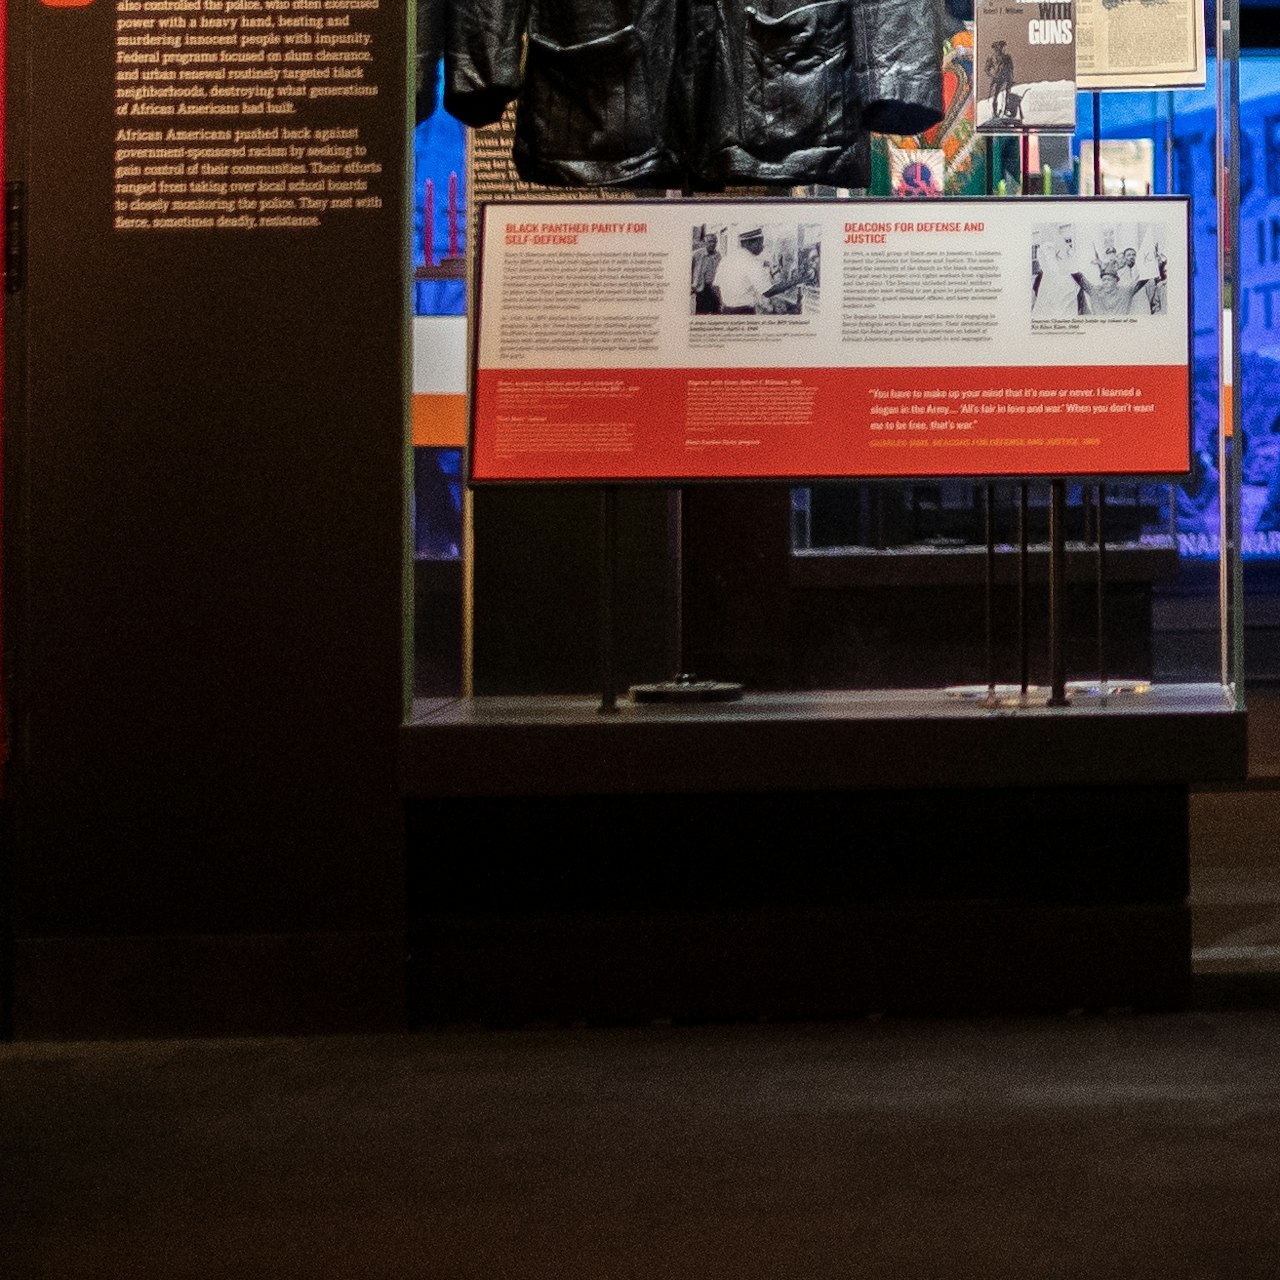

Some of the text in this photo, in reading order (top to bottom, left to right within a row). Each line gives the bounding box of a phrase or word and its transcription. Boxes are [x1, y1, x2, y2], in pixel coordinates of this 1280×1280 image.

[1038, 3, 1072, 19] WITH
[1028, 19, 1073, 45] GUNS
[505, 222, 647, 235] BLACK PANTHER PARTY FOR
[844, 221, 985, 234] DEACONS FOR DEFENSE AND
[505, 234, 579, 246] SELF-DEFENSE
[844, 233, 887, 245] JUSTICE
[890, 389, 911, 399] have
[912, 390, 922, 399] to
[924, 389, 947, 399] make
[948, 390, 960, 400] up
[961, 390, 980, 400] your
[982, 388, 1003, 398] mind
[1004, 388, 1023, 398] that
[1038, 389, 1057, 398] now
[1058, 389, 1068, 398] or
[1101, 388, 1134, 398] learned
[871, 405, 899, 416] slogan
[901, 405, 909, 414] in
[911, 405, 925, 414] the
[981, 403, 996, 414] fair
[997, 404, 1006, 414] in
[1007, 404, 1025, 414] love
[1026, 403, 1043, 414] and
[1065, 403, 1091, 414] When
[1092, 404, 1108, 415] you
[1132, 403, 1154, 413] want
[870, 422, 884, 431] me
[885, 421, 895, 431] to
[896, 420, 907, 431] be
